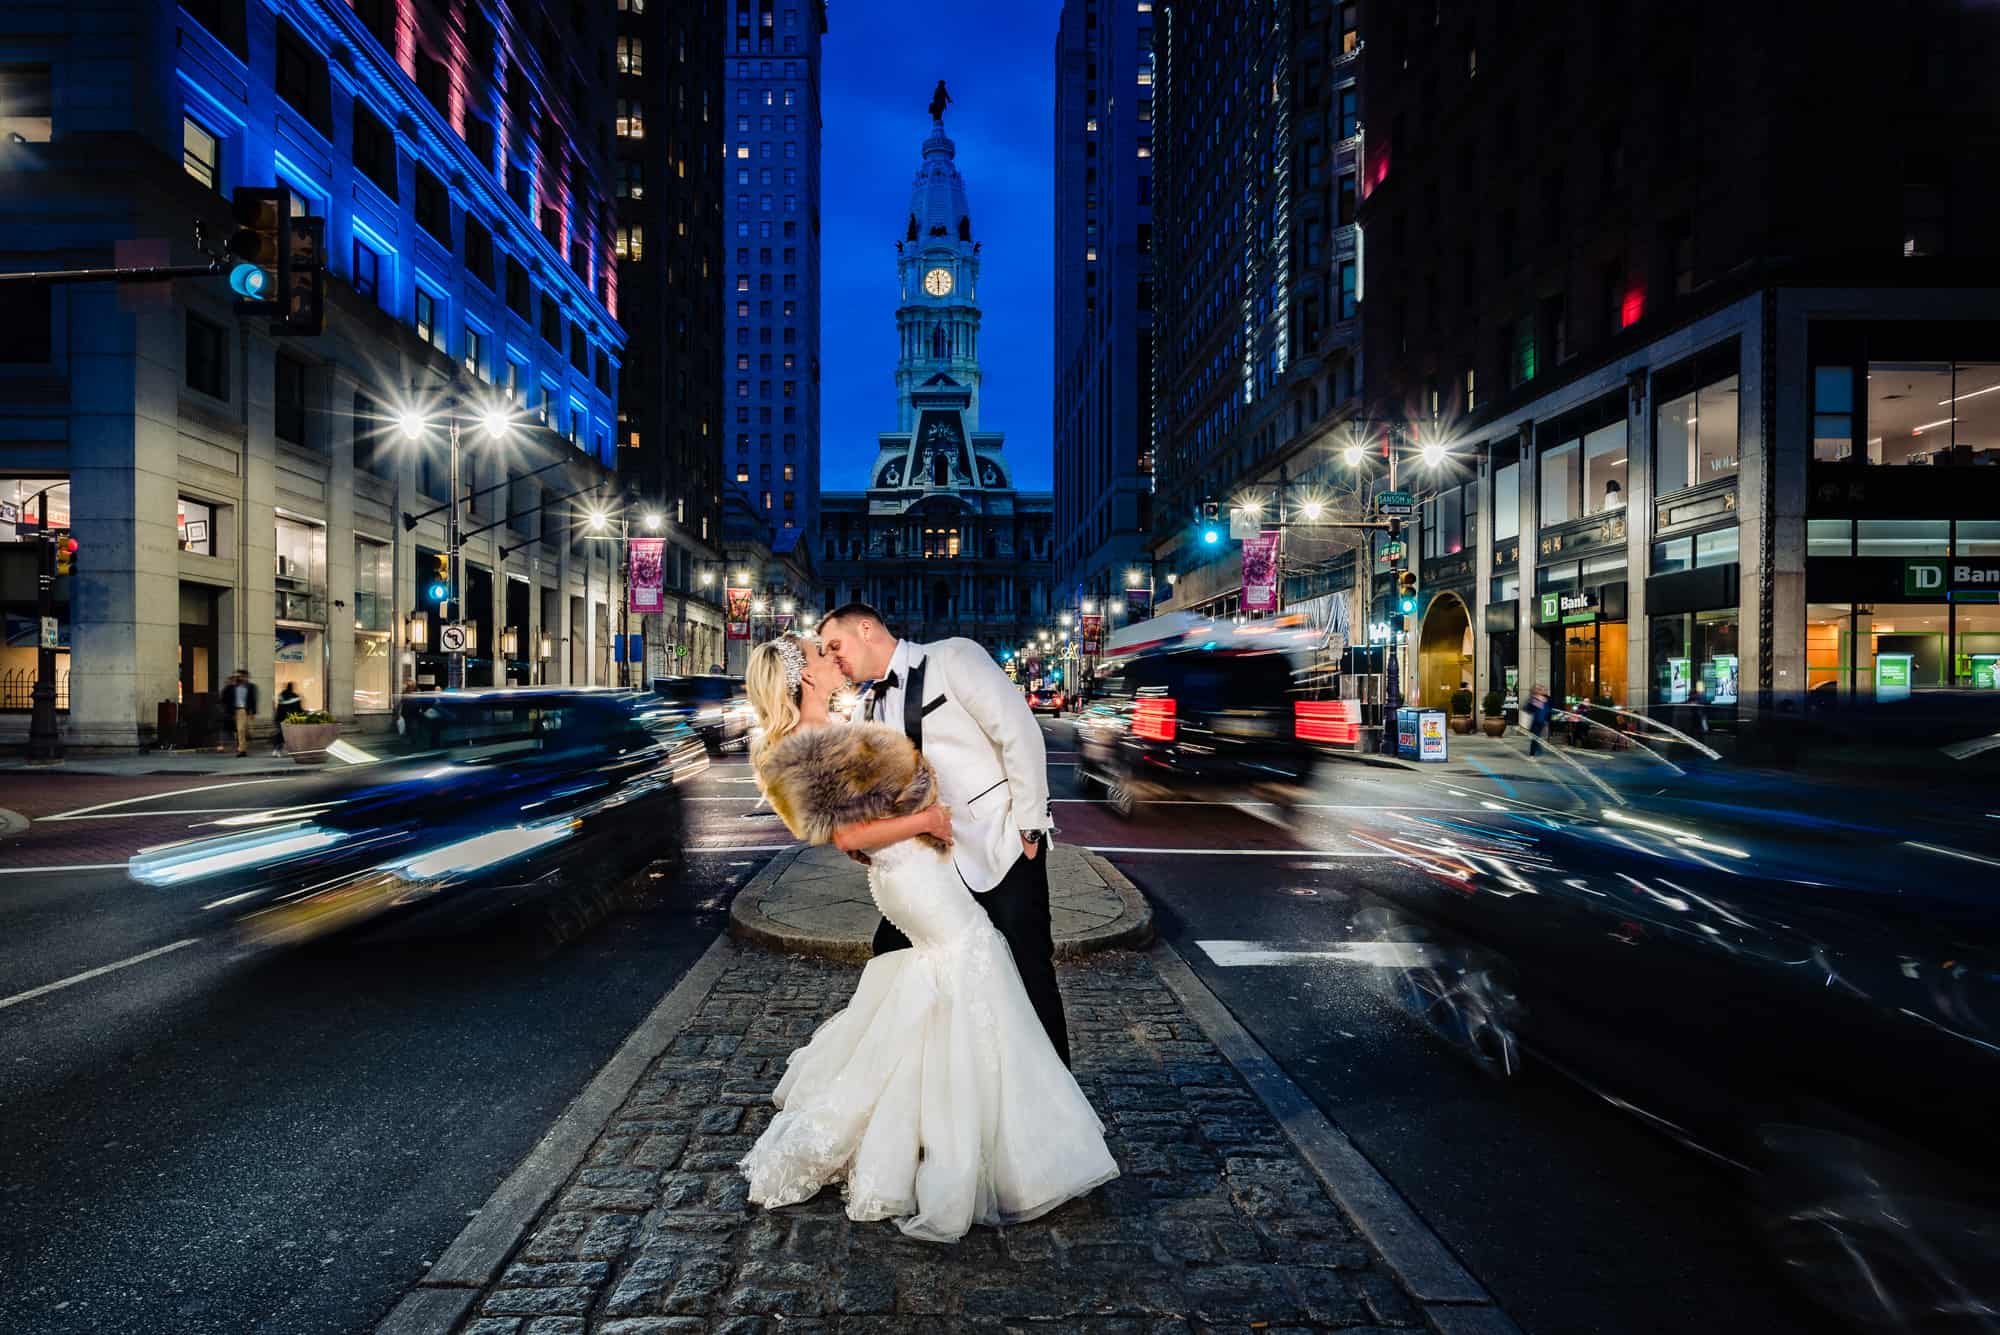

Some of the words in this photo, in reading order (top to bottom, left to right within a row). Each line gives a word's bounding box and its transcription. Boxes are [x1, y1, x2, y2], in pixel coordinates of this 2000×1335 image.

[1379, 495, 1405, 505] SANSOM
[1909, 565, 1942, 589] TD
[1543, 599, 1556, 617] TD
[1560, 593, 1588, 610] Bank
